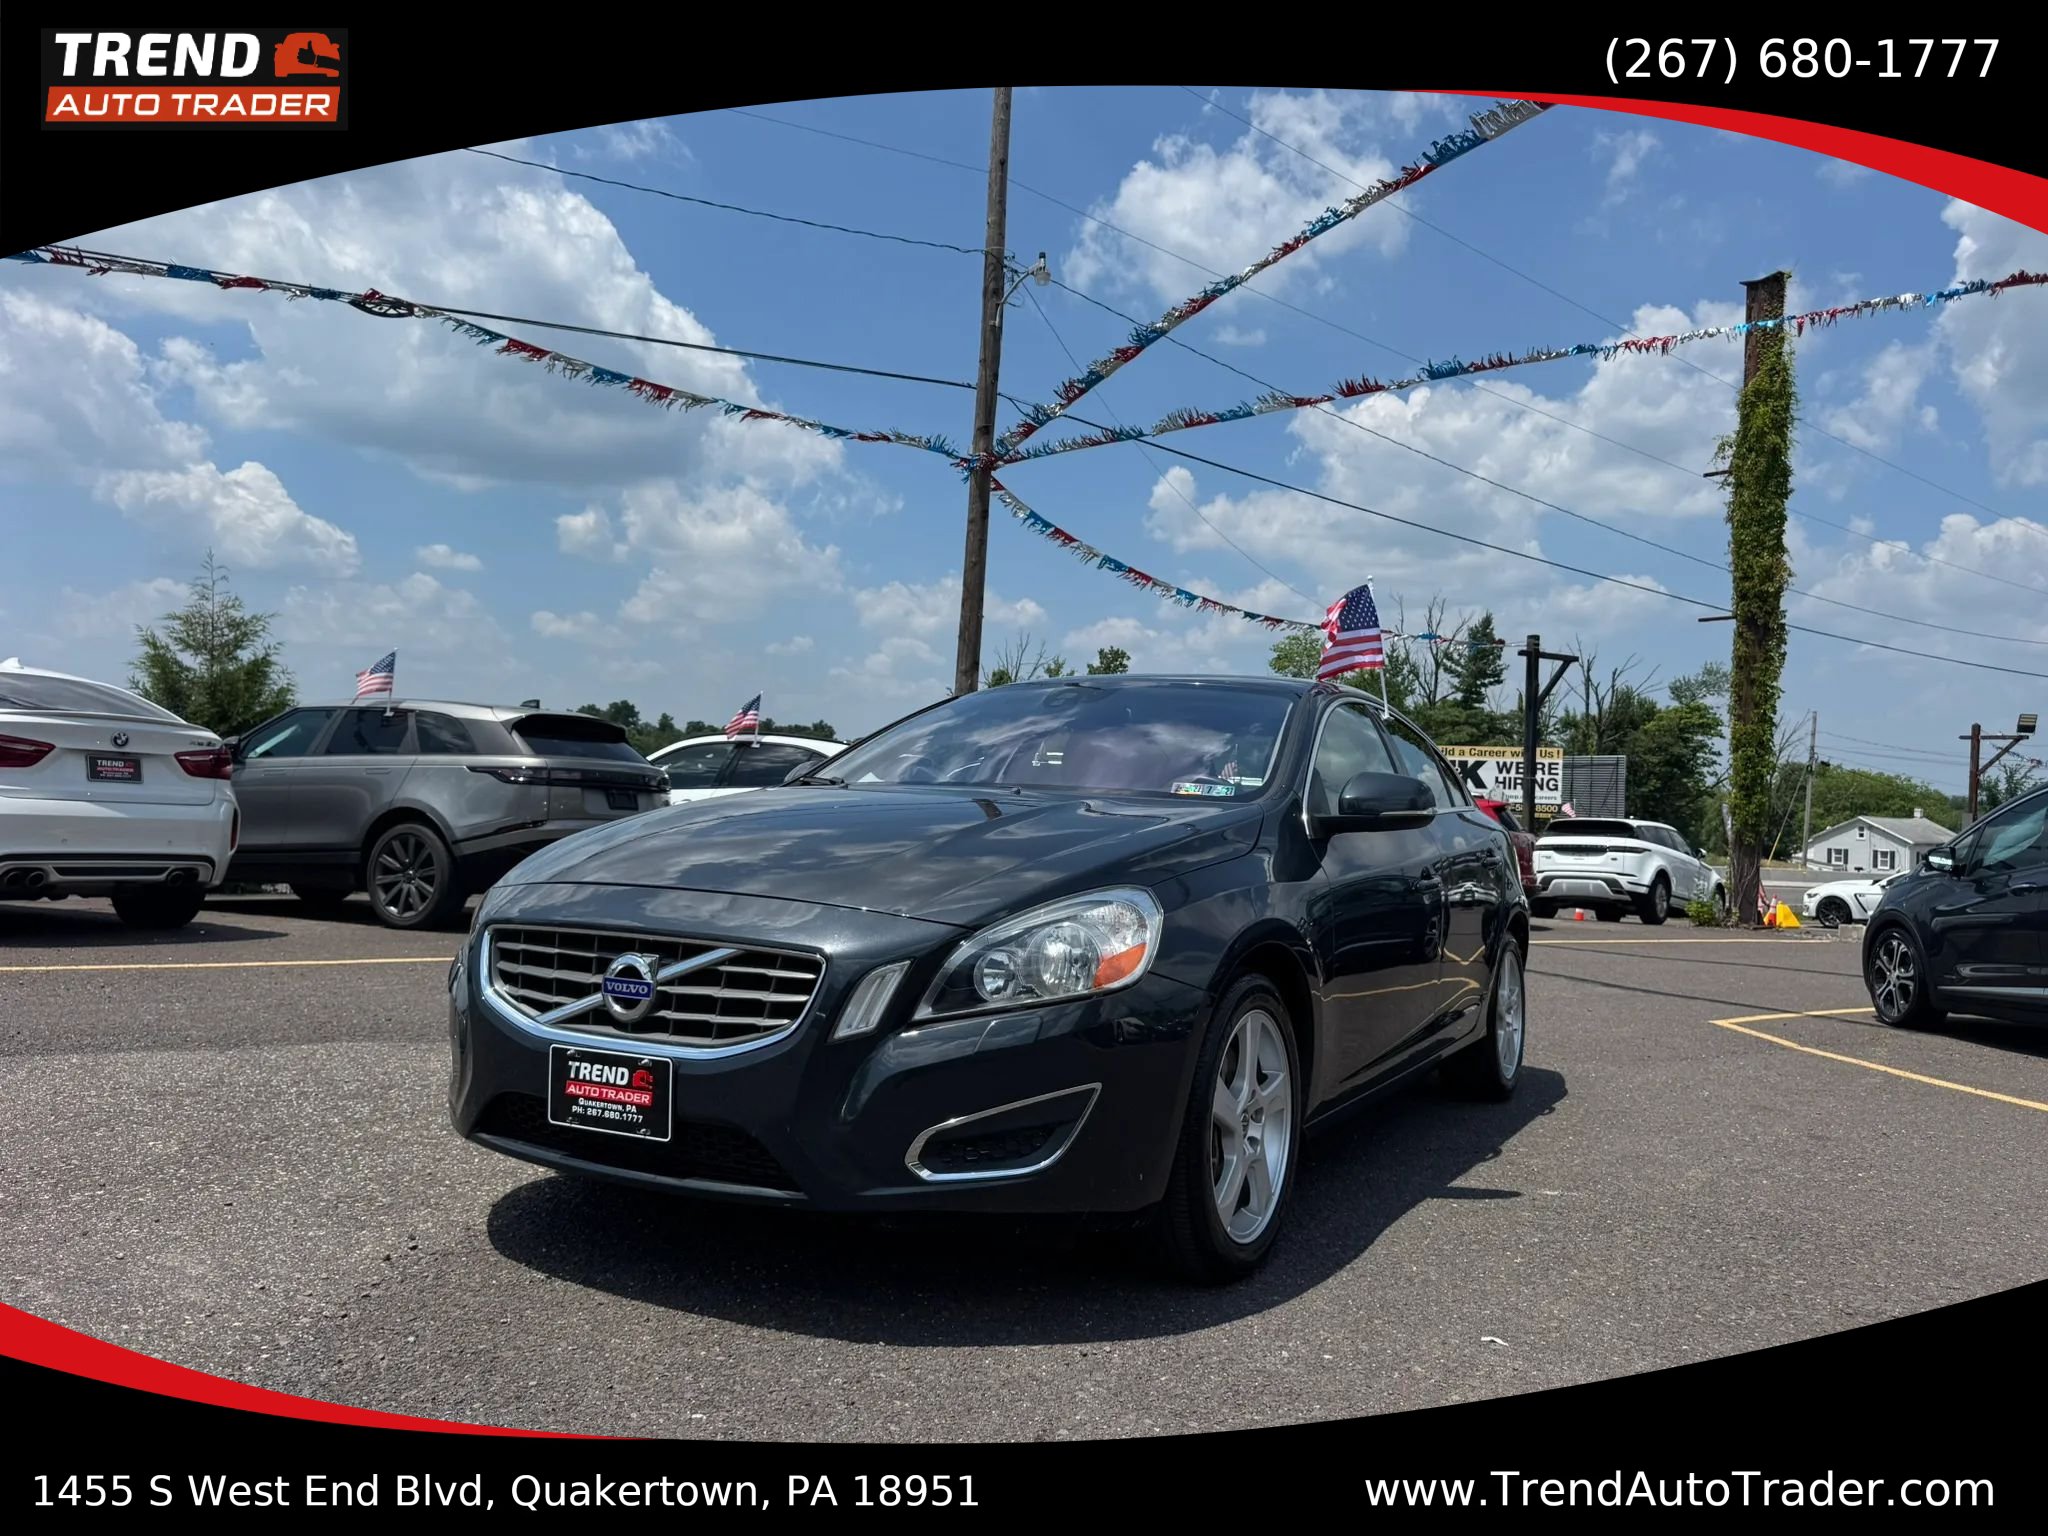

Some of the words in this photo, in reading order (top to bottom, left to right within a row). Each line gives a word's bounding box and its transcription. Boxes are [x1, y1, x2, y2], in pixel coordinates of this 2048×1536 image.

[1469, 747, 1507, 757] Career
[1540, 749, 1554, 758] Us
[1495, 776, 1558, 791] HIRNG
[606, 981, 648, 994] VOLVO
[568, 1060, 629, 1086] TREND
[567, 1084, 599, 1097] AUTO
[602, 1088, 650, 1104] TRADER
[571, 1105, 586, 1115] PH:
[587, 1109, 643, 1123] 267.680.1777
[626, 1104, 637, 1114] PA
